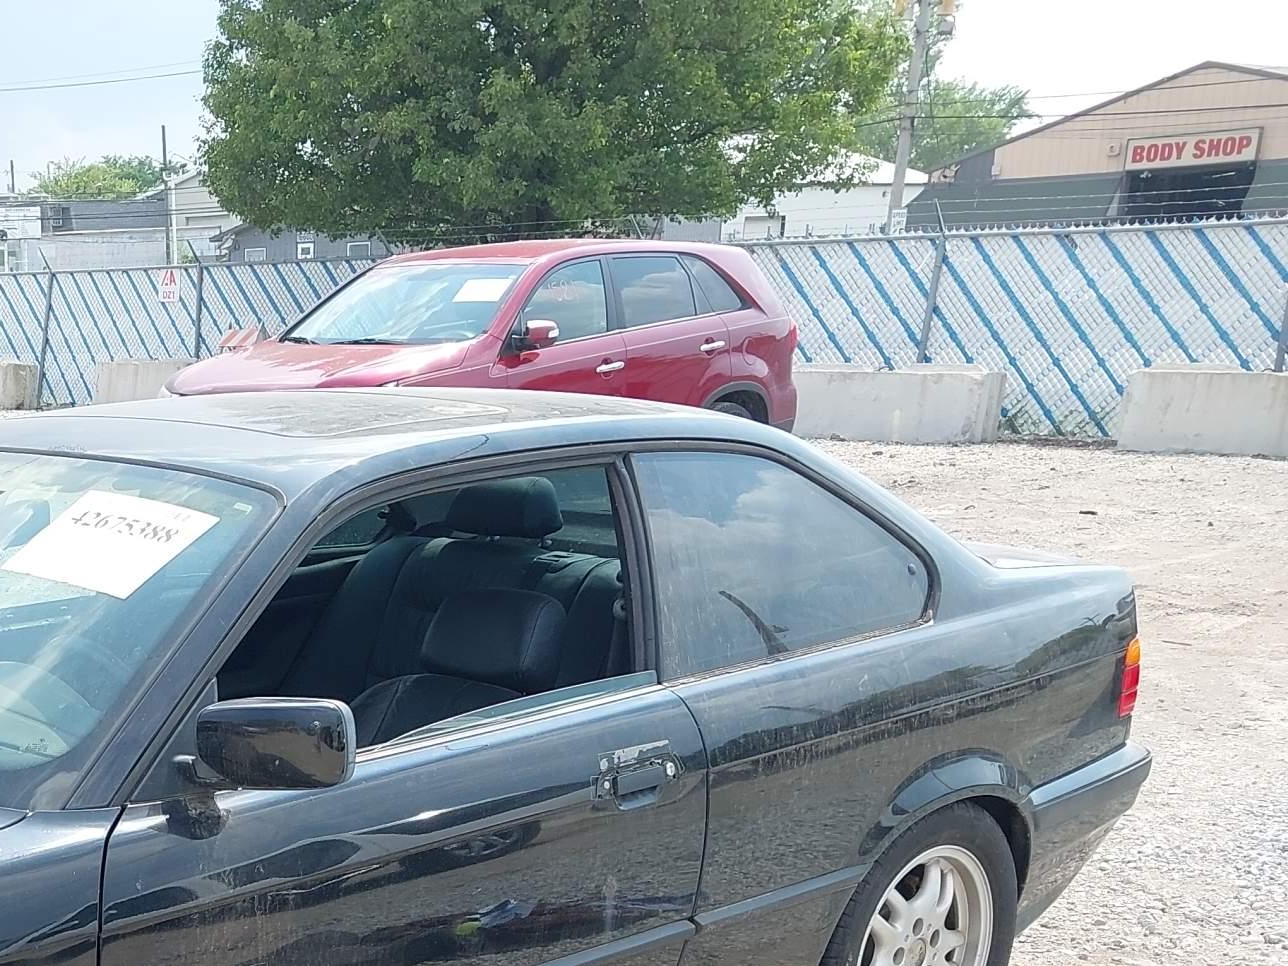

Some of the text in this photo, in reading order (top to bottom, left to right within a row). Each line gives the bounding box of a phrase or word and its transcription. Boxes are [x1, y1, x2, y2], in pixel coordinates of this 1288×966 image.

[1131, 135, 1253, 164] BODY SHOP
[72, 510, 179, 543] 42675388
